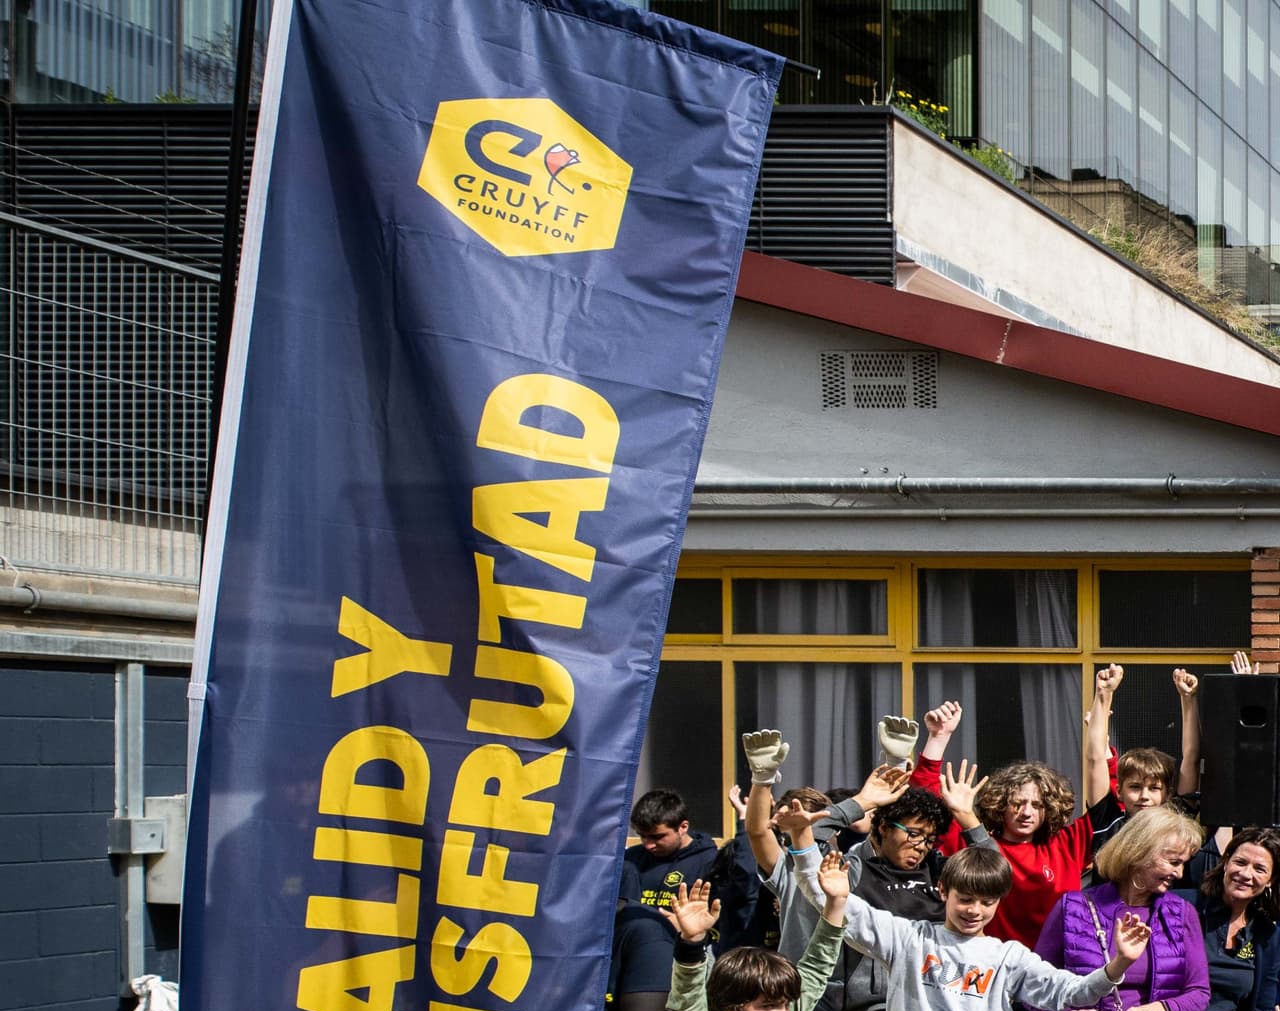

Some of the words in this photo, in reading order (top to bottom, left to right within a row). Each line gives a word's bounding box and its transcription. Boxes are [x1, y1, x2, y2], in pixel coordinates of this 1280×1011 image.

[453, 174, 589, 228] CRUYFF
[457, 198, 575, 243] FOUNDATION
[331, 595, 453, 698] Y
